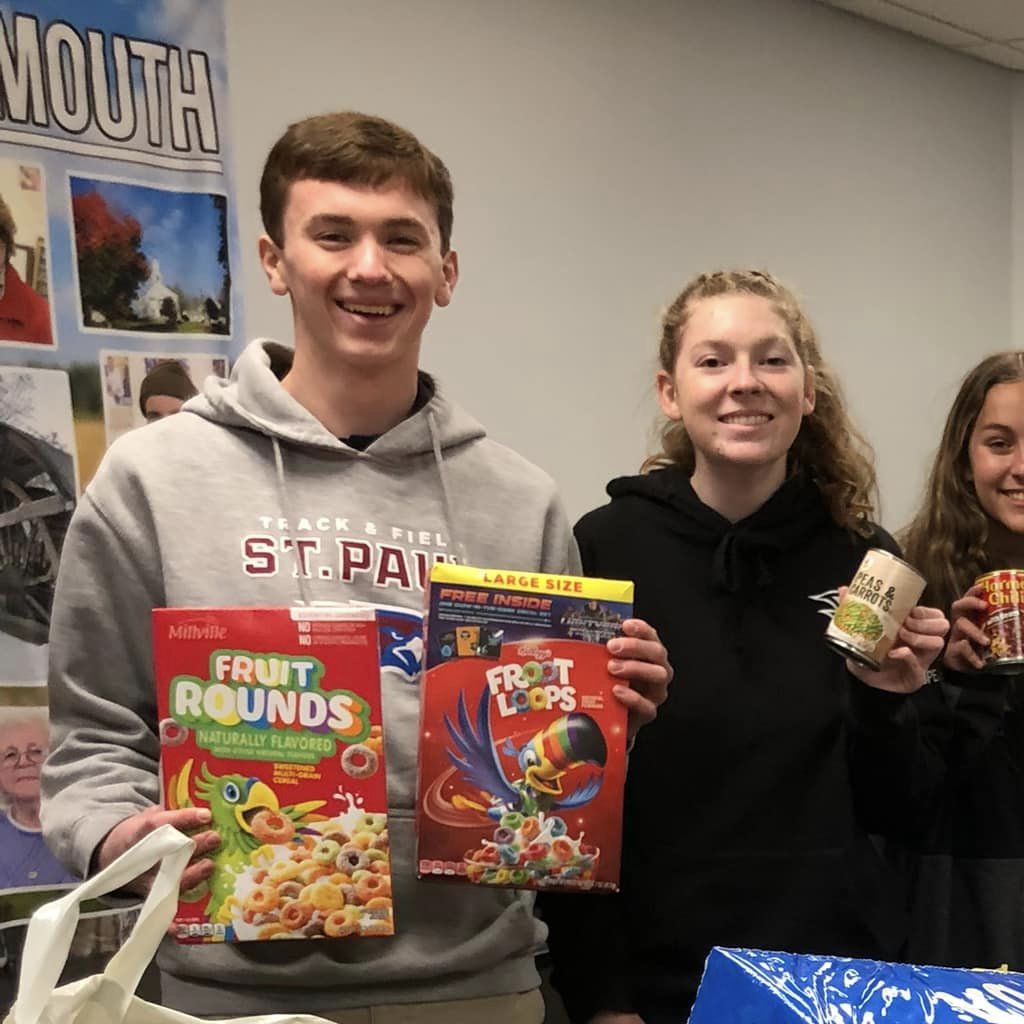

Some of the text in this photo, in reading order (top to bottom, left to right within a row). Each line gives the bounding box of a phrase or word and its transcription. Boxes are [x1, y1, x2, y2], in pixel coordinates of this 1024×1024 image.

[259, 516, 448, 547] TRACK & FIEL
[484, 573, 583, 593] LARGE SIZE
[849, 583, 892, 612] CARROTS
[856, 570, 896, 600] PEAS &
[440, 588, 489, 605] FREE
[493, 594, 552, 611] INSIDE
[988, 590, 1024, 606] Chili
[168, 624, 228, 640] Millville
[215, 655, 315, 688] FRUIT
[485, 657, 574, 696] FROOT
[174, 680, 364, 737] ROUNDS
[496, 684, 577, 718] LOOPS
[200, 729, 333, 752] NATURALLY FLAVORED
